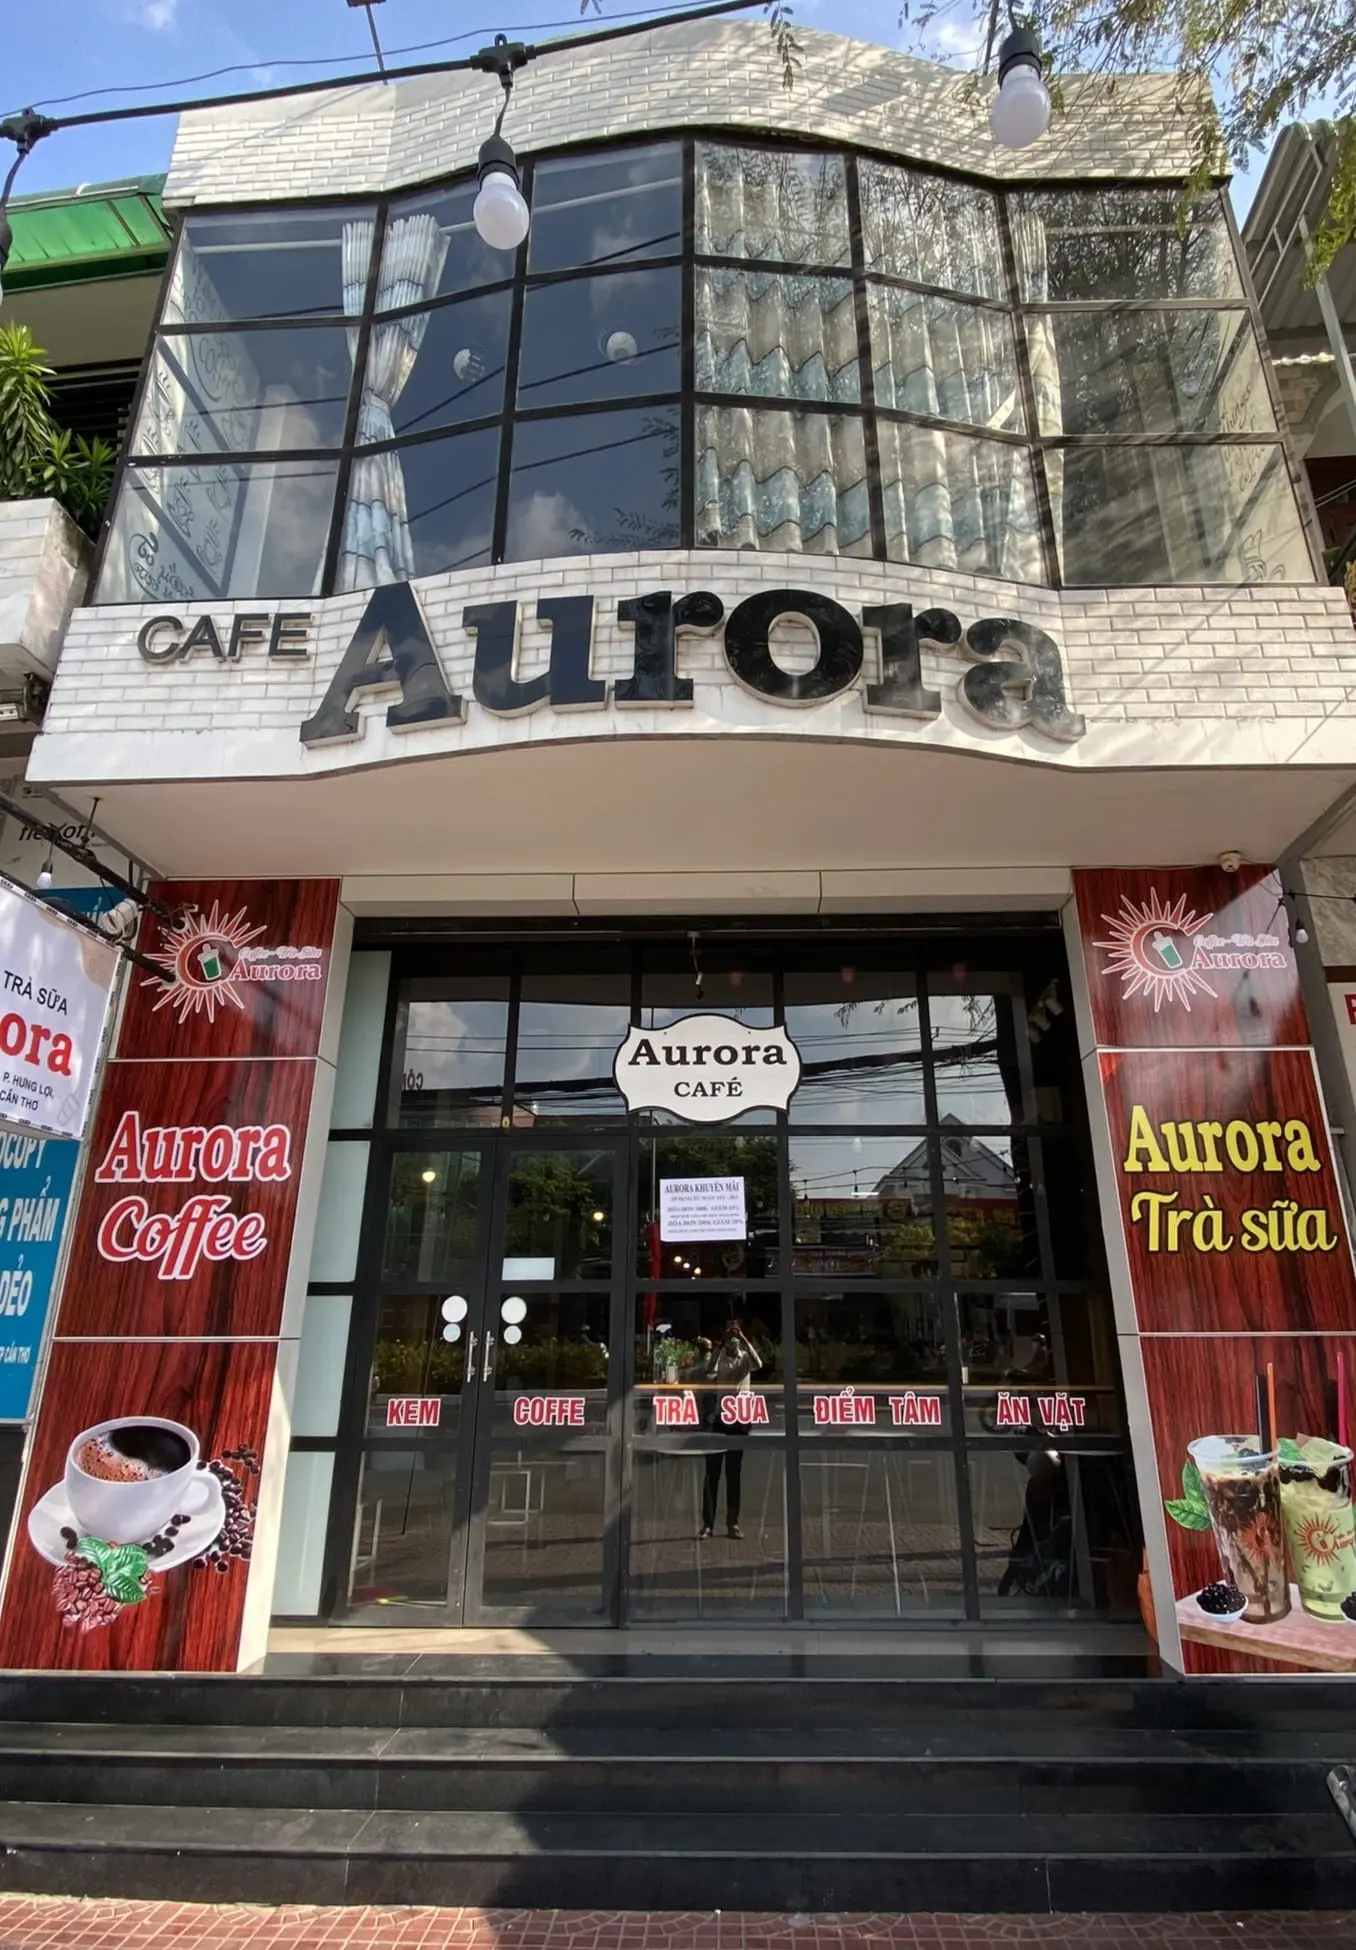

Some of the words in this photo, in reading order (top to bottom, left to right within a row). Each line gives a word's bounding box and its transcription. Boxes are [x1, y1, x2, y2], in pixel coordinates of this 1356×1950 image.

[138, 612, 313, 664] CAFE
[301, 581, 1086, 747] Aurora
[228, 959, 322, 981] Aurora
[1191, 946, 1287, 970] Aurora
[3, 970, 33, 1000] TRÀ
[37, 986, 68, 1016] SỮA
[628, 1038, 787, 1067] Aurora
[673, 1076, 744, 1098] CAFÉ
[94, 1110, 292, 1183] Aurora
[1123, 1104, 1321, 1173] Aurora
[7, 1175, 60, 1242] PHẨM
[664, 1183, 694, 1194] AURORA
[97, 1195, 268, 1281] Coffee
[1130, 1189, 1235, 1253] Trà
[1240, 1199, 1339, 1253] sữa
[386, 1398, 441, 1427] KEM
[513, 1396, 586, 1426] COFFE
[653, 1390, 699, 1426] TRÀ
[720, 1390, 770, 1425] SỮA
[813, 1385, 876, 1425] ĐIỂM
[889, 1390, 942, 1426] TÂM
[996, 1391, 1031, 1426] ĂN
[1037, 1391, 1086, 1432] VẶT
